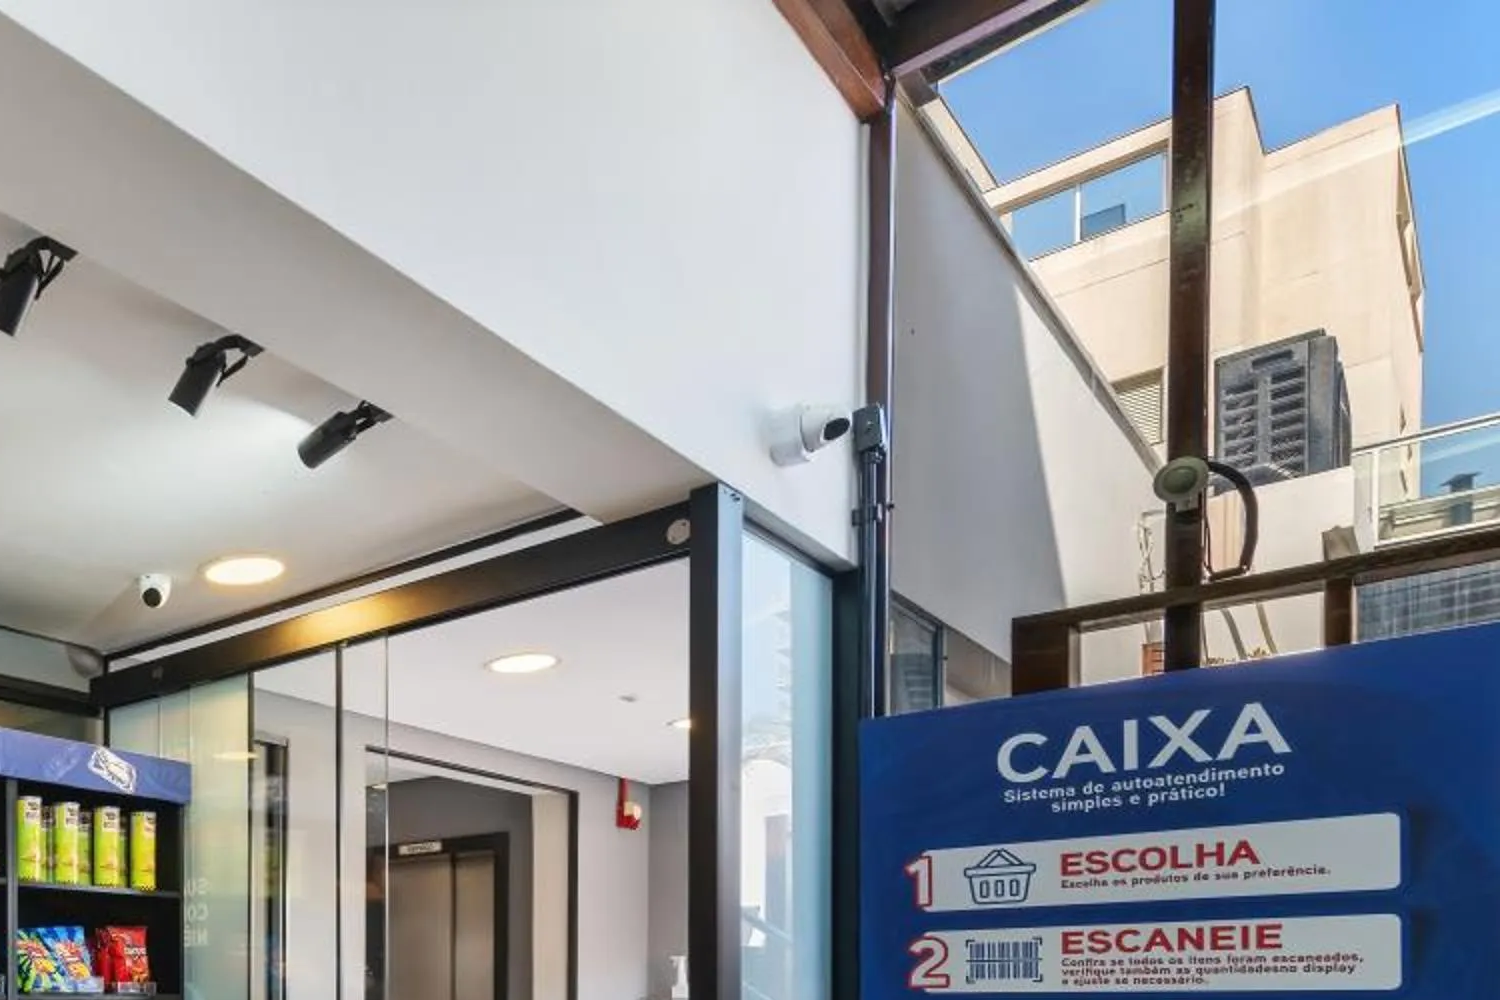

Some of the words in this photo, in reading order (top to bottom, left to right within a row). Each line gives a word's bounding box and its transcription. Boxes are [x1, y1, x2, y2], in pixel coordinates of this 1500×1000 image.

[996, 702, 1292, 784] CAIXA
[1003, 783, 1076, 804] Sistema
[1083, 780, 1104, 796] de
[1111, 762, 1285, 793] autoatendimento
[1051, 793, 1122, 814] simples
[1129, 794, 1141, 806] e
[1148, 782, 1226, 806] prático!
[1060, 840, 1260, 876] ESCOLHA
[905, 850, 934, 912] 1
[1060, 878, 1109, 889] Escolha
[1112, 878, 1127, 886] os
[1131, 873, 1188, 888] produtos
[1193, 872, 1210, 882] de
[1215, 872, 1239, 880] sua
[1243, 864, 1331, 880] preferência.
[1060, 922, 1284, 955] ESCANEIE
[907, 934, 951, 990] 2
[1061, 957, 1106, 968] Confira
[1110, 958, 1124, 967] se
[1128, 956, 1164, 966] todos
[1168, 956, 1183, 965] os
[1226, 953, 1267, 966] foram
[1061, 966, 1116, 979] verifique
[1120, 964, 1170, 976] também
[1176, 967, 1191, 975] as
[1303, 962, 1357, 976] display
